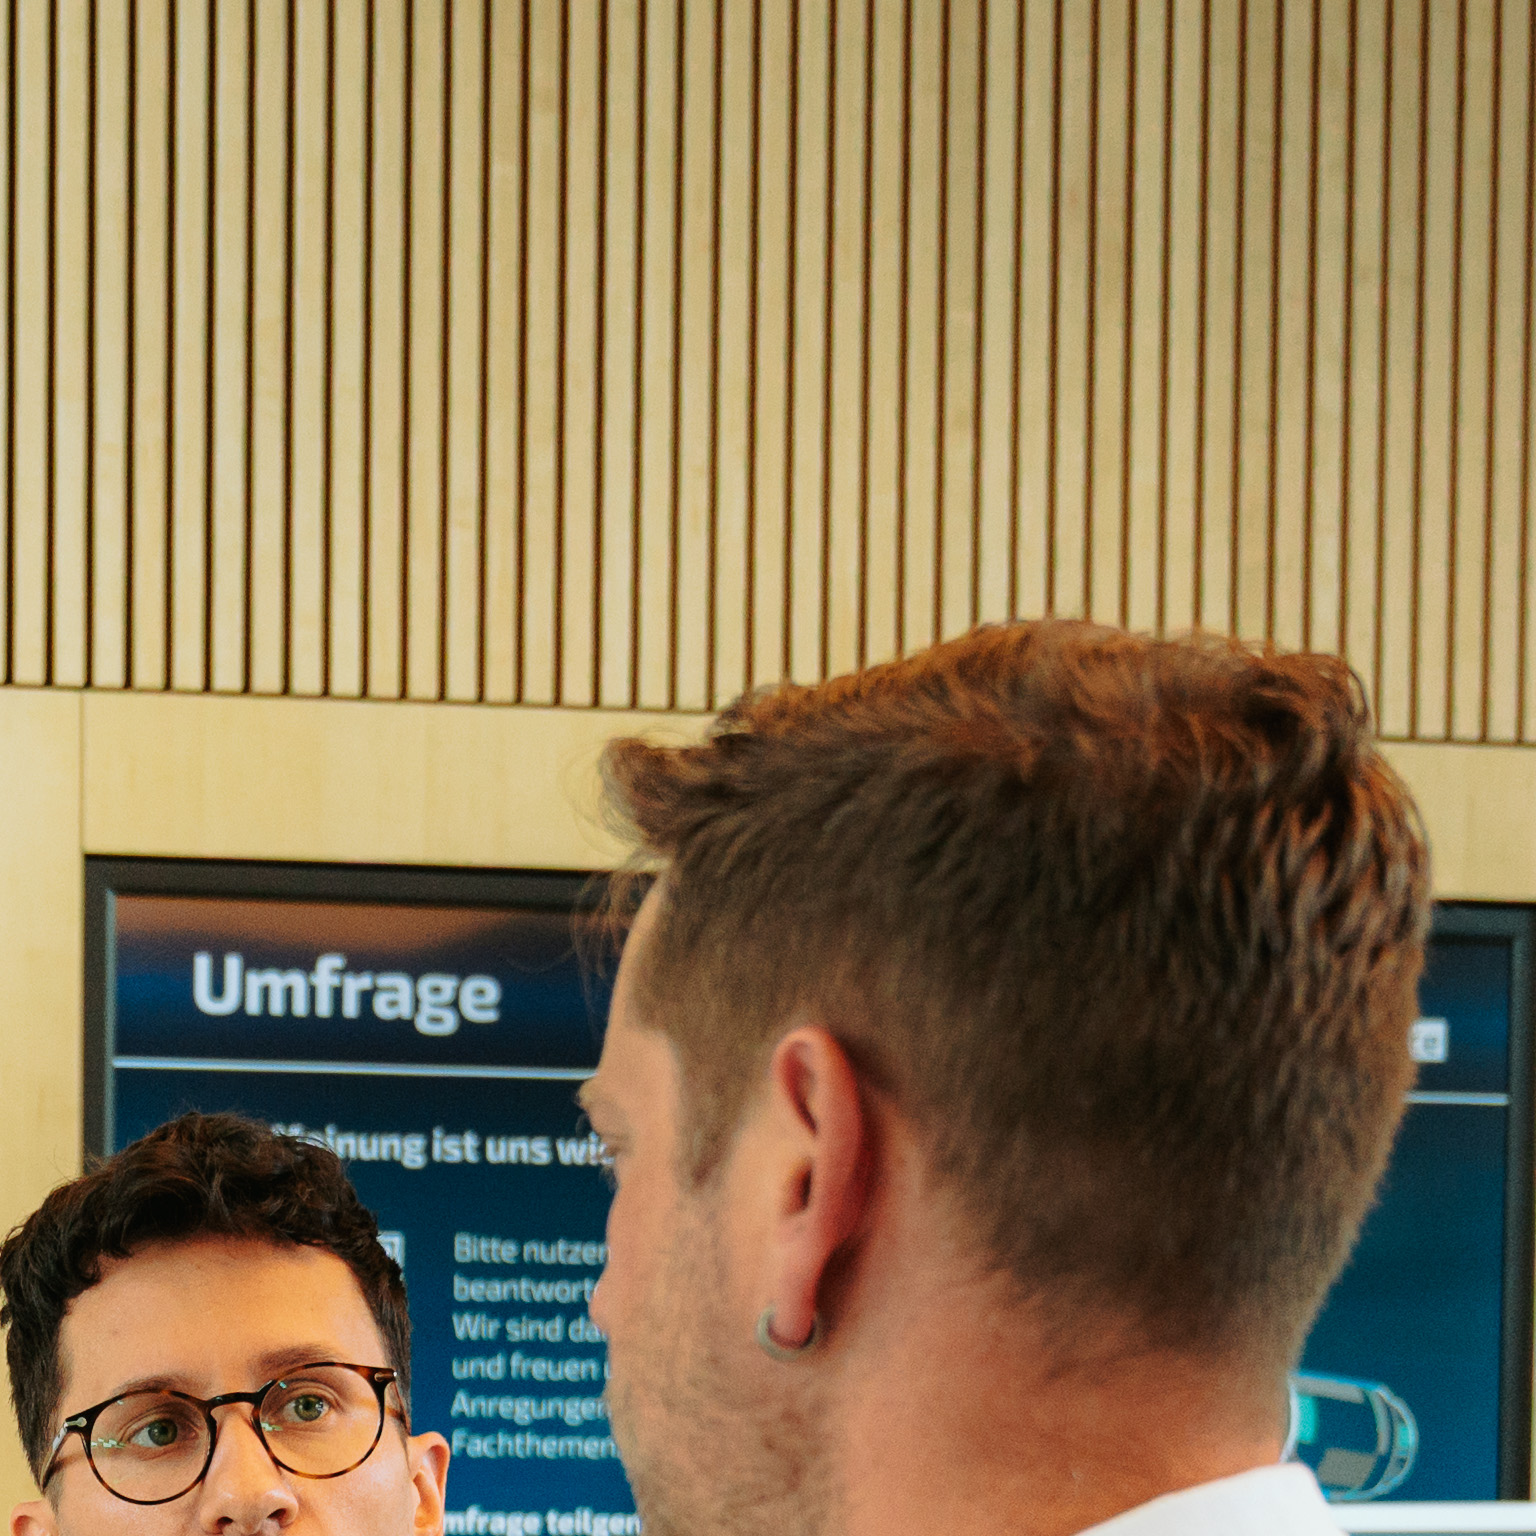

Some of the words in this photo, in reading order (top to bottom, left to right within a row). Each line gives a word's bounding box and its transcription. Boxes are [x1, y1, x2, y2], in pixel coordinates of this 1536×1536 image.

[192, 951, 502, 1035] Umfrage
[271, 1122, 428, 1169] inung
[432, 1126, 480, 1163] ist
[485, 1136, 553, 1165] uns
[454, 1232, 518, 1264] Bitte
[453, 1274, 598, 1303] beantwort
[452, 1312, 501, 1341] Wir
[506, 1313, 563, 1342] sind
[452, 1352, 505, 1380] und
[511, 1352, 597, 1381] freuen
[450, 1391, 610, 1426] Anregungen
[452, 1429, 620, 1459] Fachthemen
